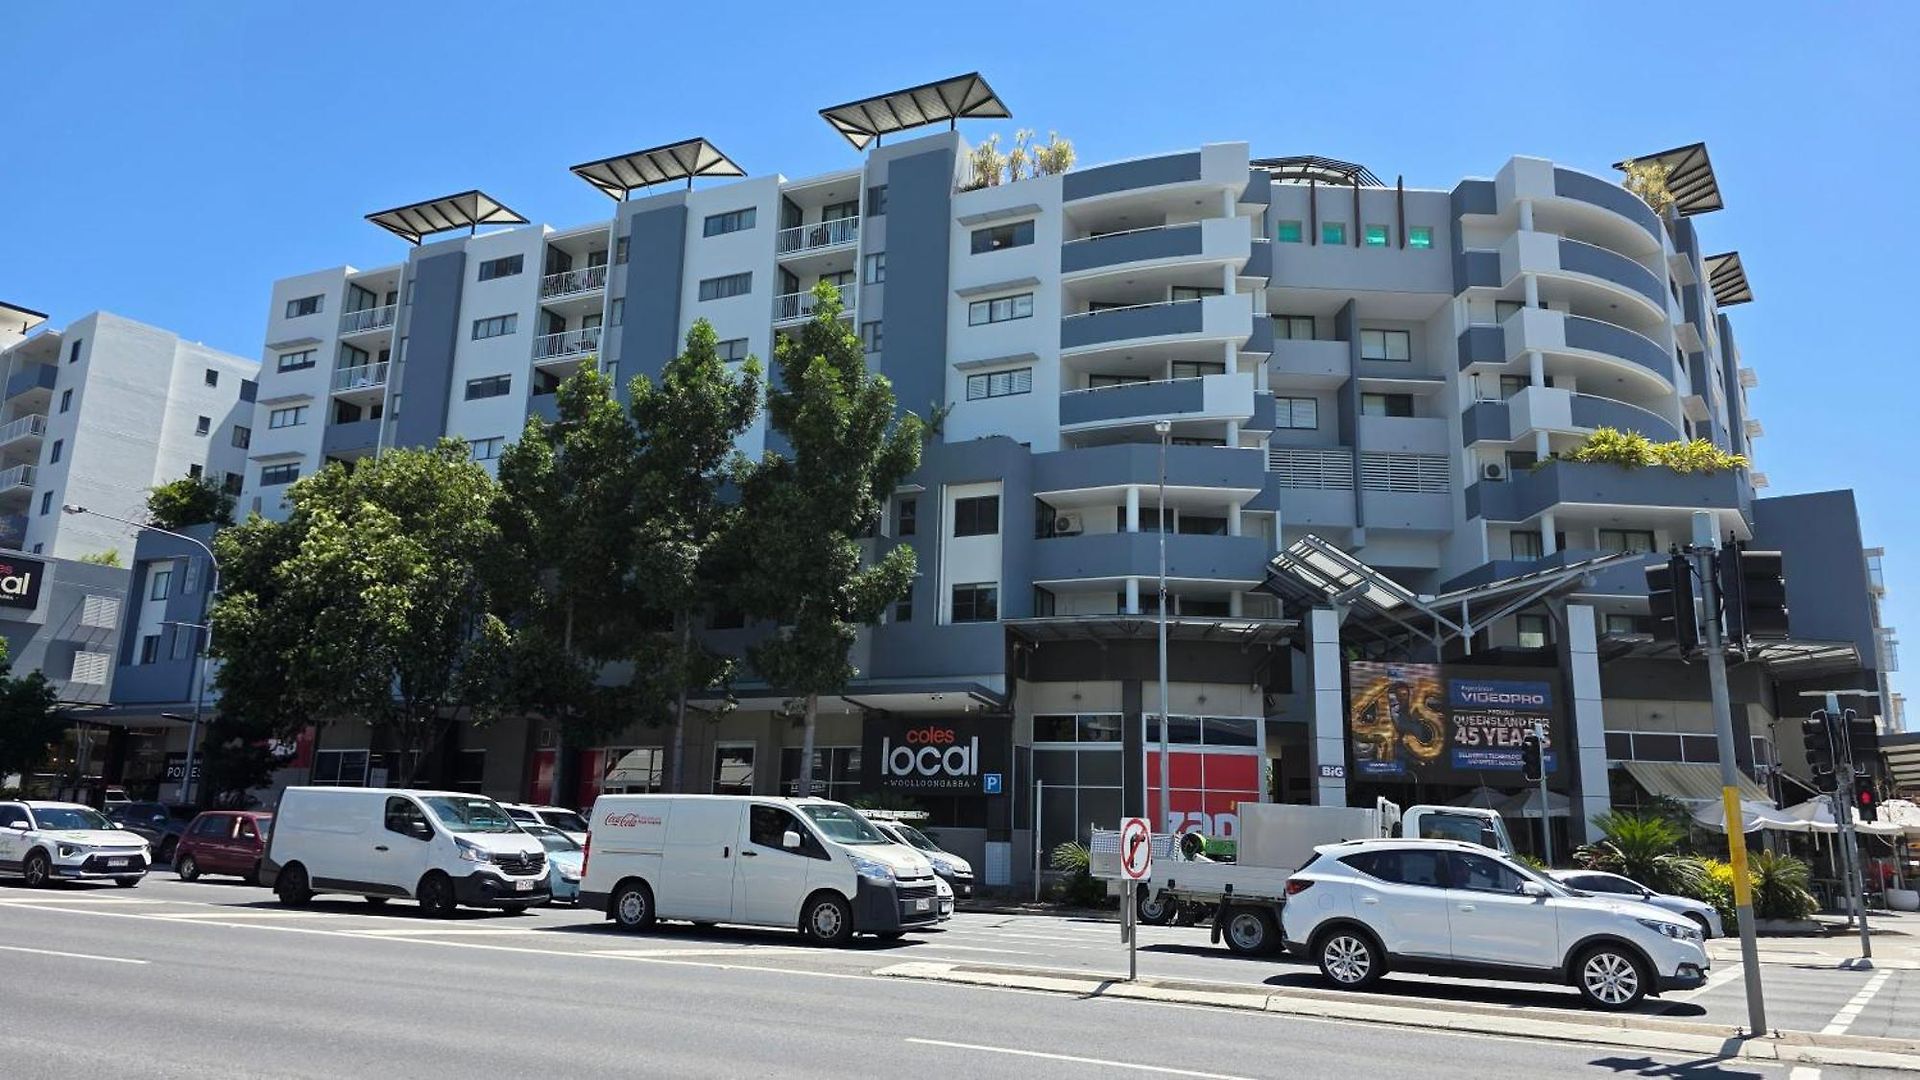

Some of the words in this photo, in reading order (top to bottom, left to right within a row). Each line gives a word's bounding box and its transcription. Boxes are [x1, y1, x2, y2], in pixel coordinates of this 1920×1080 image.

[1460, 692, 1545, 705] VIDEOPRO
[1453, 715, 1527, 728] QUEENSLAND
[906, 726, 956, 744] coles
[1454, 727, 1480, 746] 45
[881, 736, 979, 776] local
[890, 779, 970, 788] WOOLLOONGABBA
[987, 776, 998, 790] P
